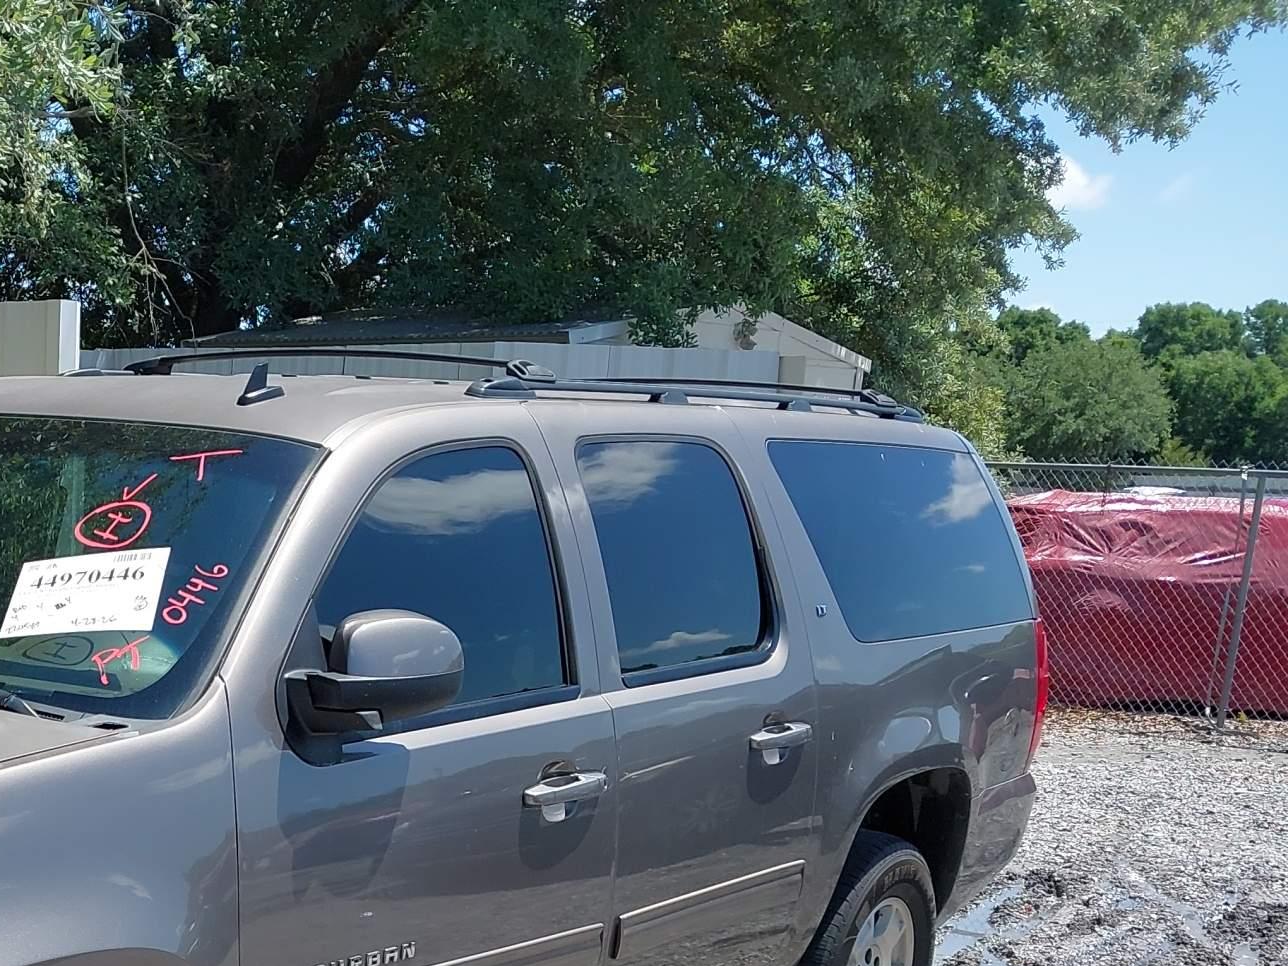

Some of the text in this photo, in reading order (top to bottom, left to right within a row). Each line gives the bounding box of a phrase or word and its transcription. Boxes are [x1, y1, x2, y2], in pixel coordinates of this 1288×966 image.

[169, 449, 244, 482] T
[29, 565, 146, 590] 44970446
[162, 563, 229, 625] 0446
